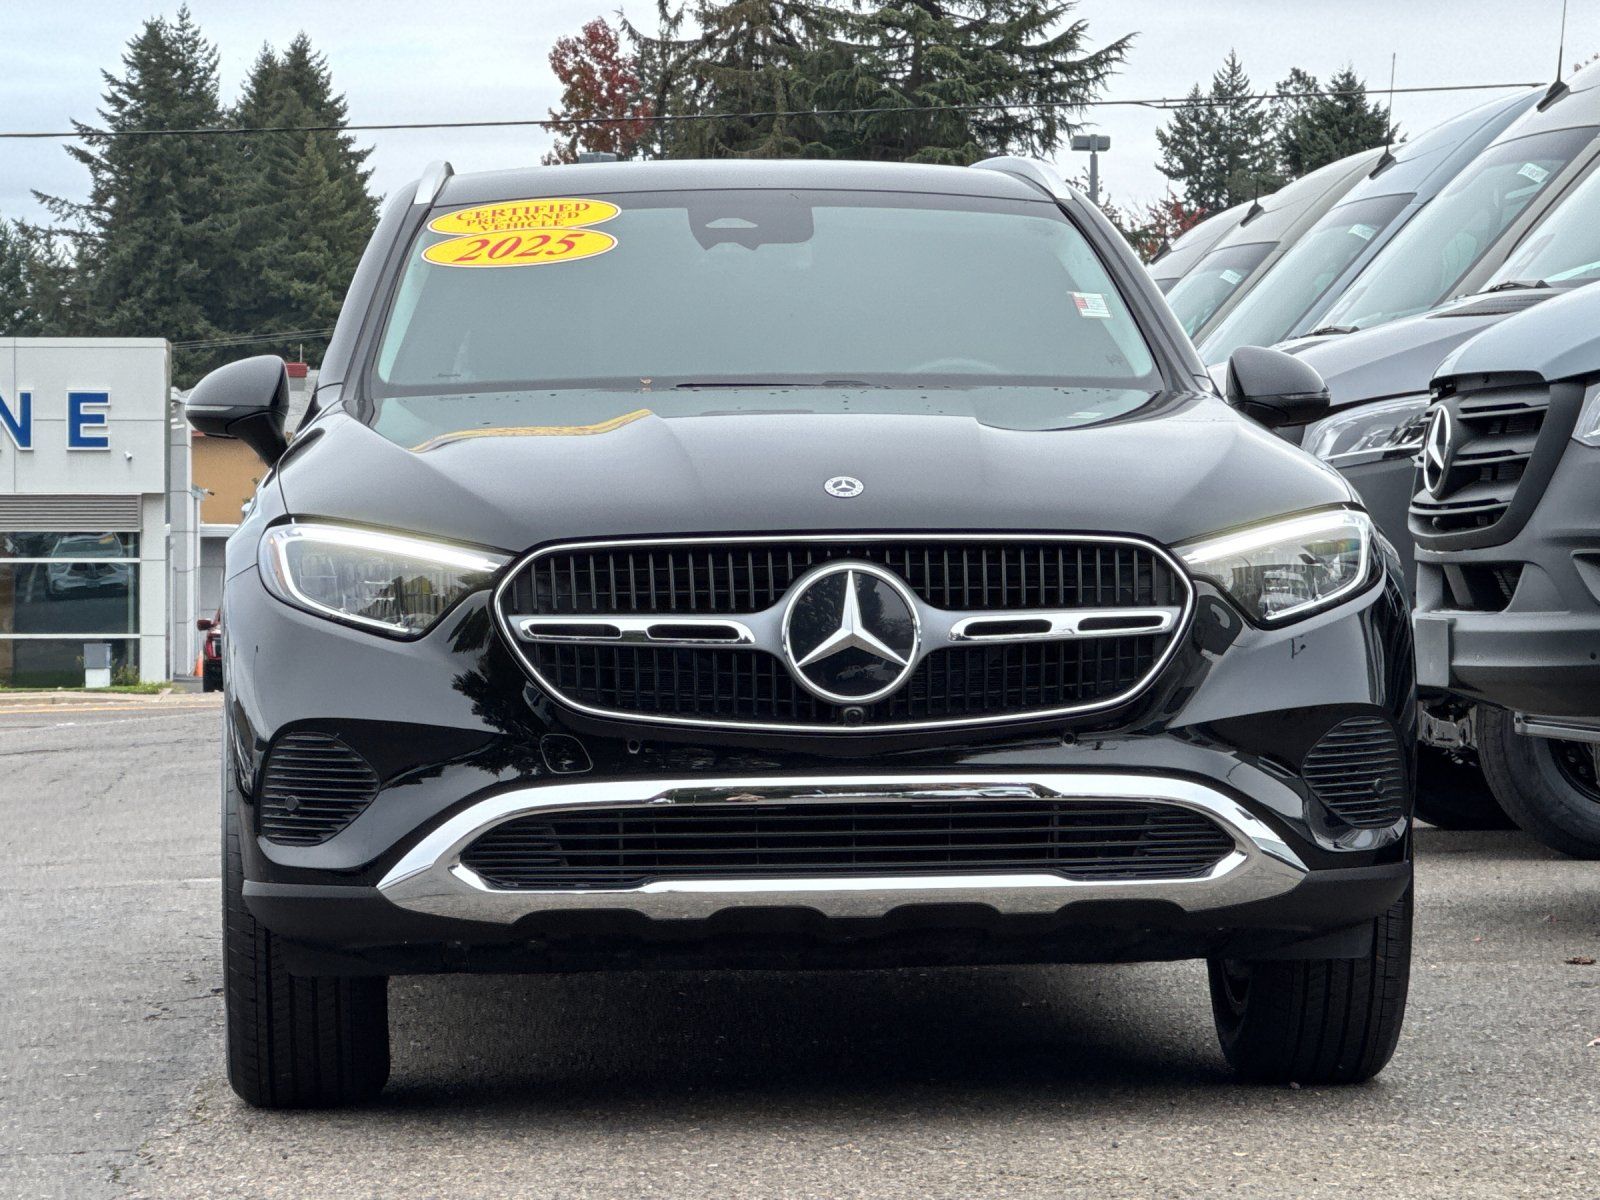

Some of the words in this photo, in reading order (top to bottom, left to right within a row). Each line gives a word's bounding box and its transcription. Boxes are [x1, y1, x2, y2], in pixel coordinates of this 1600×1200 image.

[456, 203, 590, 221] CERTIFIED
[466, 212, 580, 227] PRE-OWNED
[480, 219, 564, 231] VEHICLE
[452, 233, 586, 262] 2025
